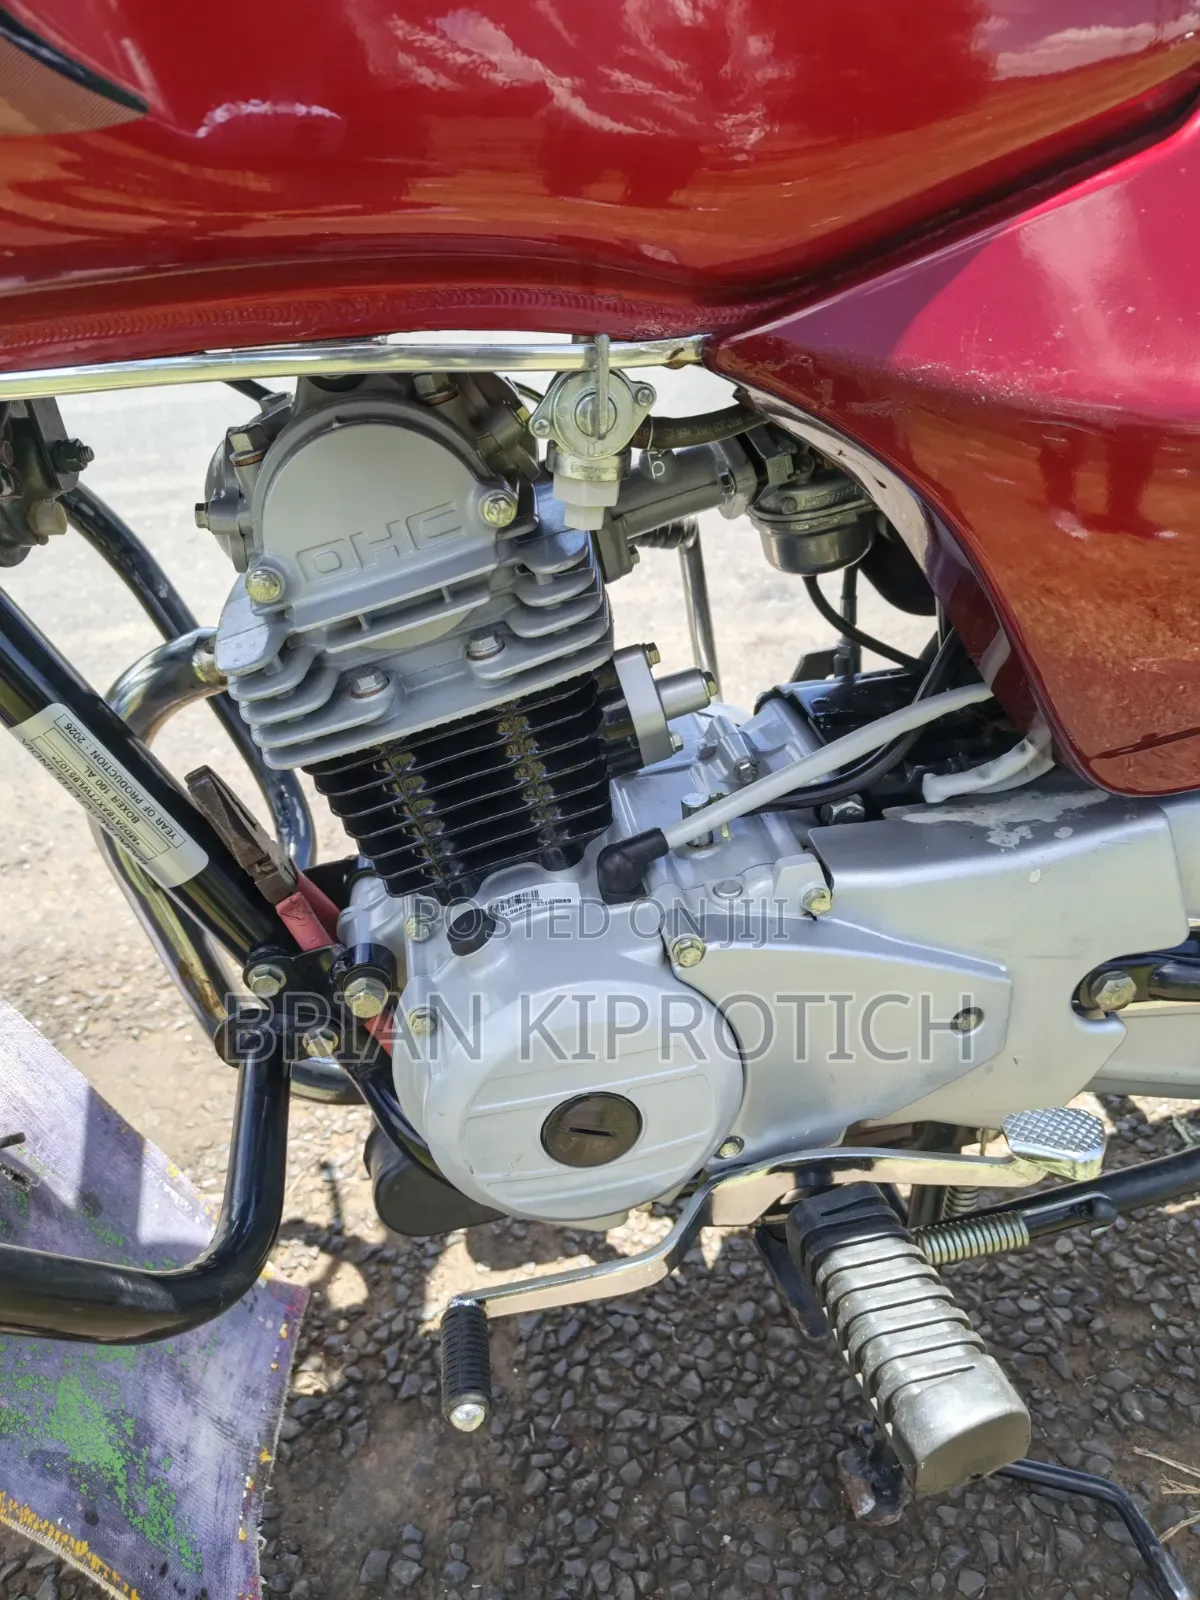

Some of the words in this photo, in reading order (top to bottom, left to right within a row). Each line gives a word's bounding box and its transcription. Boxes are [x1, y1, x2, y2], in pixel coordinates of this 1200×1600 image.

[295, 500, 467, 585] OHC
[64, 722, 86, 745] 2026
[82, 765, 97, 780] AL
[89, 749, 145, 805] PRODUCTION
[94, 778, 112, 795] 100
[110, 794, 141, 824] BOXER
[141, 803, 157, 818] OF
[155, 816, 178, 840] YEAR
